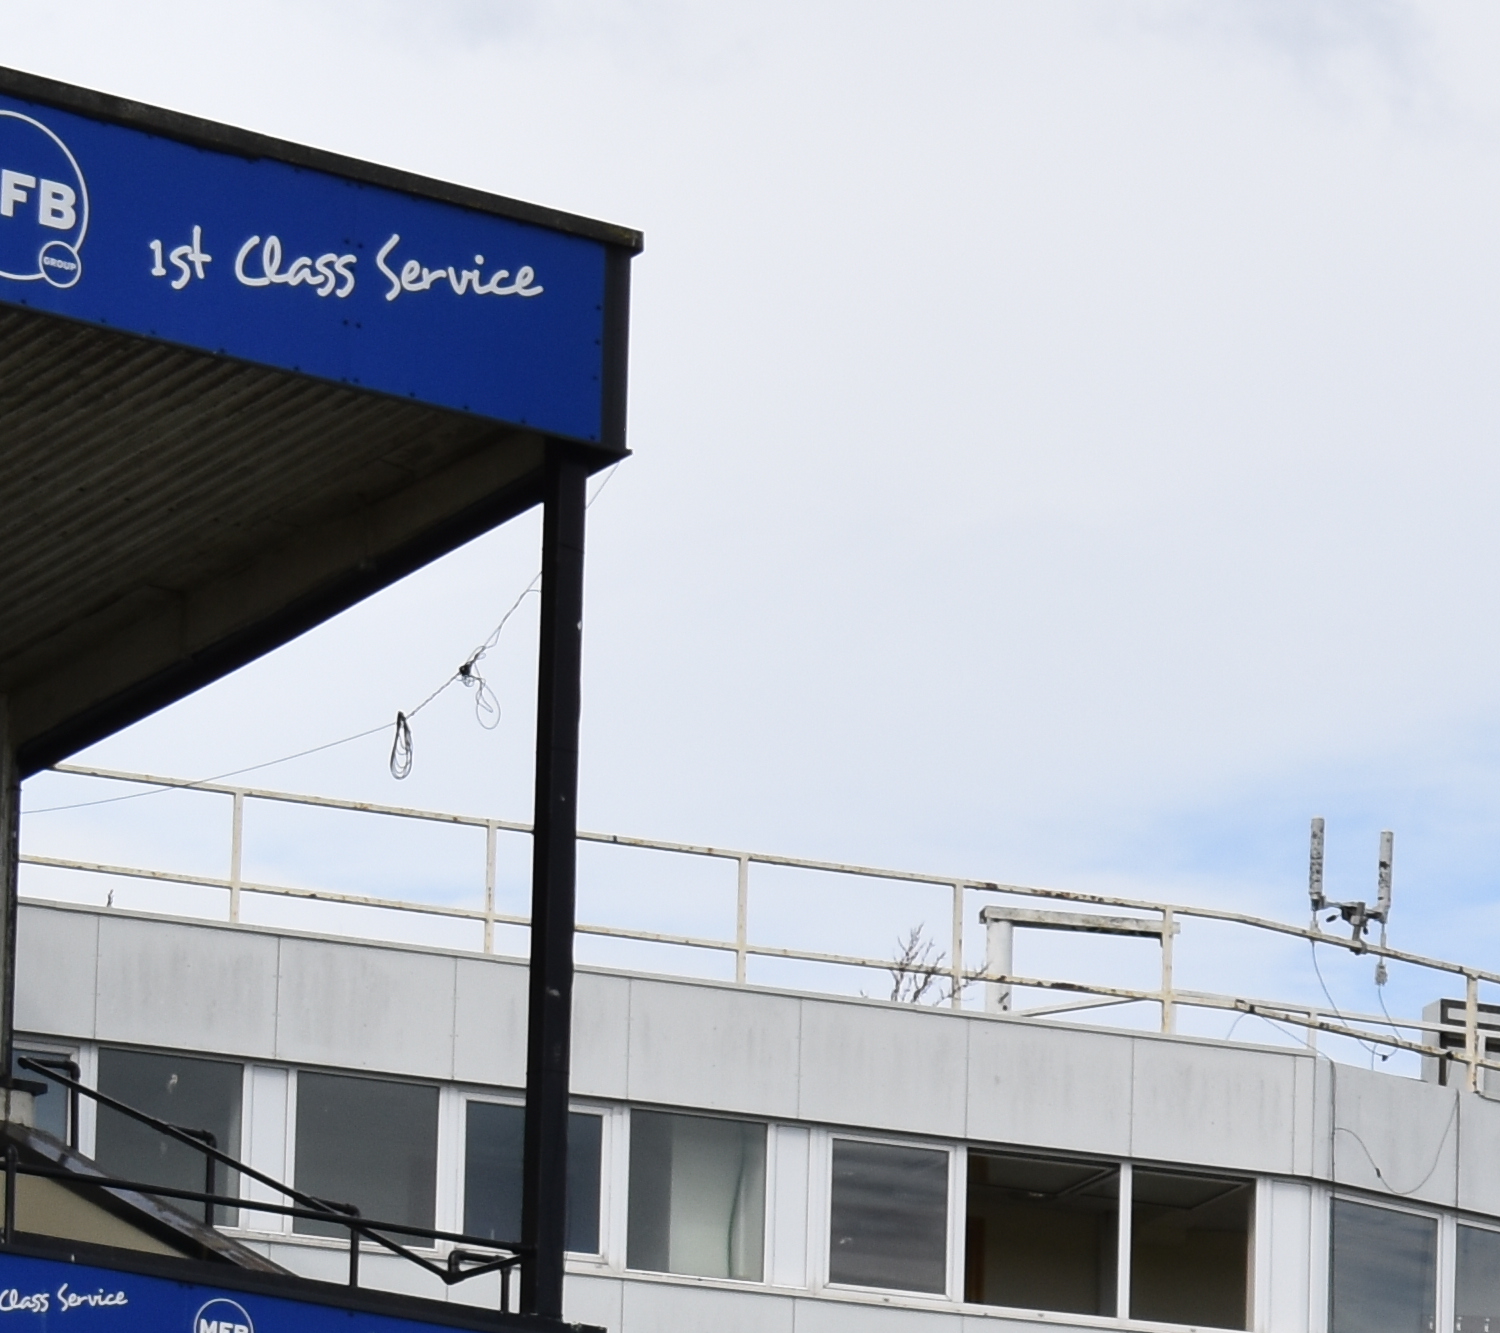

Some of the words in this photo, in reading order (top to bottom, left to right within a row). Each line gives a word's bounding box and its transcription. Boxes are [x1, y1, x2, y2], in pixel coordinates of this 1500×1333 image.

[0, 168, 77, 230] FB
[43, 255, 77, 272] GROUP
[149, 225, 212, 290] 1st
[234, 235, 358, 297] Class
[376, 233, 544, 301] Service
[0, 1288, 50, 1313] Class
[57, 1283, 129, 1312] Service
